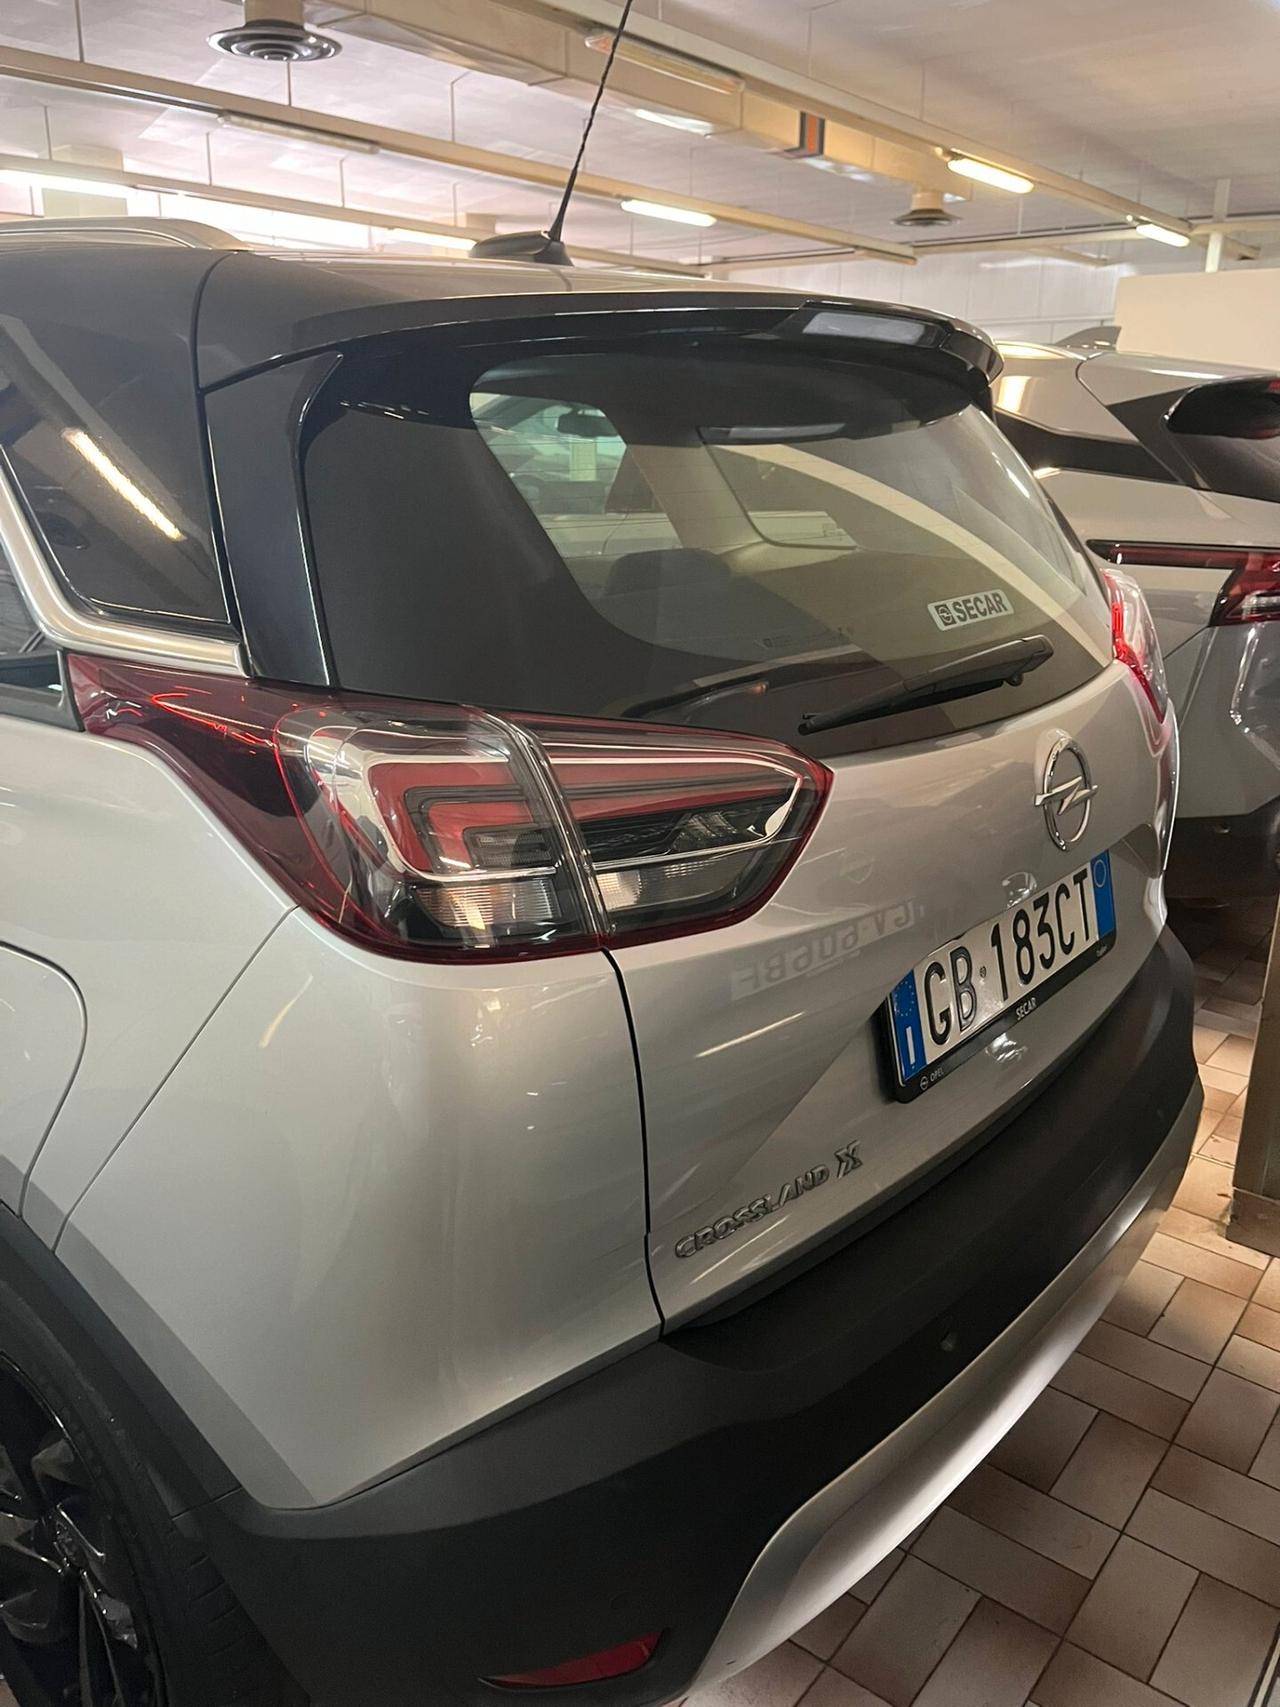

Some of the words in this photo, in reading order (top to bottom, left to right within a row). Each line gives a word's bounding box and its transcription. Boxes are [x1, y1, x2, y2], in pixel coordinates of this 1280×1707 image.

[952, 592, 1008, 622] SECAR
[924, 946, 977, 1045] GB
[991, 868, 1088, 1001] 183CT
[1015, 997, 1037, 1020] SECAR
[930, 1067, 944, 1082] OPEL
[675, 1164, 830, 1258] CROSSLAND
[834, 1139, 863, 1179] X
